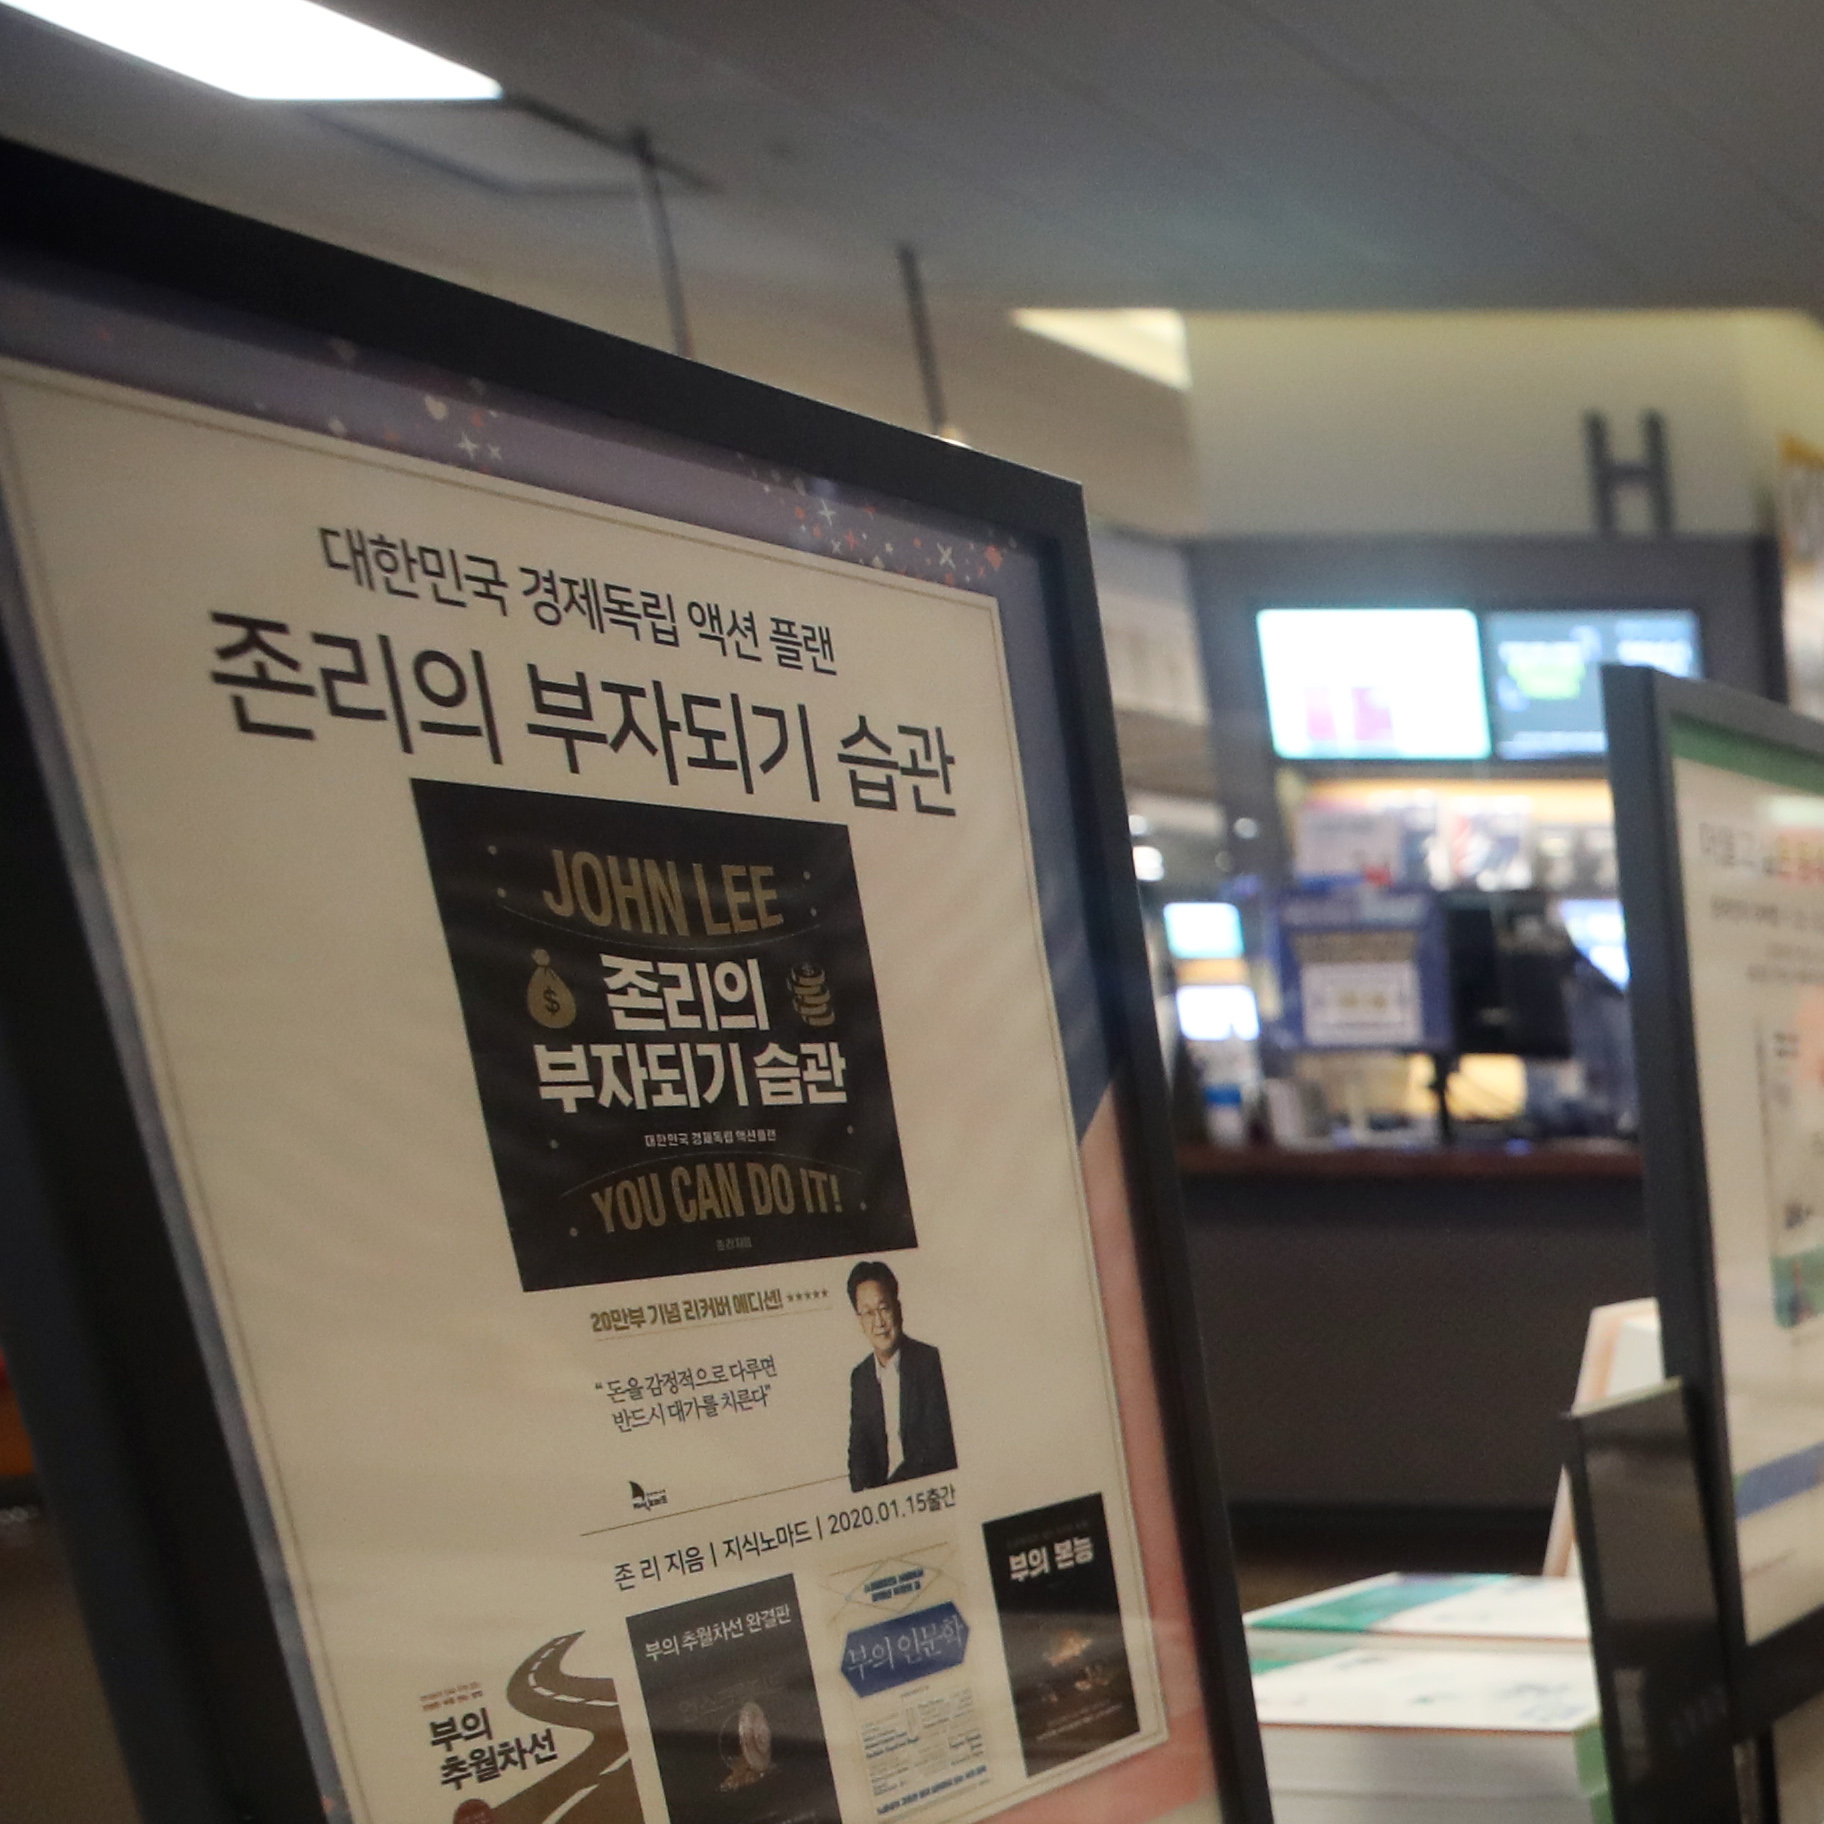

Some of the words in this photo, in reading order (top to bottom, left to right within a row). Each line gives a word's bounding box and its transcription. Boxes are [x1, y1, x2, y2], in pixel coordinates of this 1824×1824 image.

[318, 525, 511, 613] 대한민국
[519, 564, 679, 647] 경제독립
[686, 601, 761, 664] 액션
[768, 620, 838, 676] 플랜
[209, 610, 502, 764] 존리의
[527, 662, 820, 802] 부자되기
[837, 713, 957, 818] 습관
[543, 849, 691, 937] JOHN
[699, 863, 785, 936] LEE
[600, 954, 771, 1033] 존리의
[533, 1041, 750, 1113] 부자되기
[754, 1047, 848, 1107] 습관
[591, 1173, 666, 1235] YOU
[671, 1162, 744, 1224] CAN
[747, 1163, 796, 1216] DO
[801, 1170, 843, 1214] IT!
[613, 1563, 636, 1592] 존
[640, 1557, 660, 1583] 리
[665, 1545, 705, 1575] 지음
[723, 1520, 812, 1561] 지식노마드
[828, 1484, 956, 1534] 2020.01.15출간
[1009, 1548, 1050, 1582] 부의
[1054, 1536, 1094, 1569] 본능
[645, 1635, 681, 1662] 부의
[682, 1620, 744, 1652] 추월차선
[746, 1604, 793, 1633] 완결판
[847, 1636, 896, 1681] 부의
[899, 1614, 964, 1662] 인문학
[429, 1707, 492, 1752] 부의
[440, 1728, 559, 1791] 추월차선
